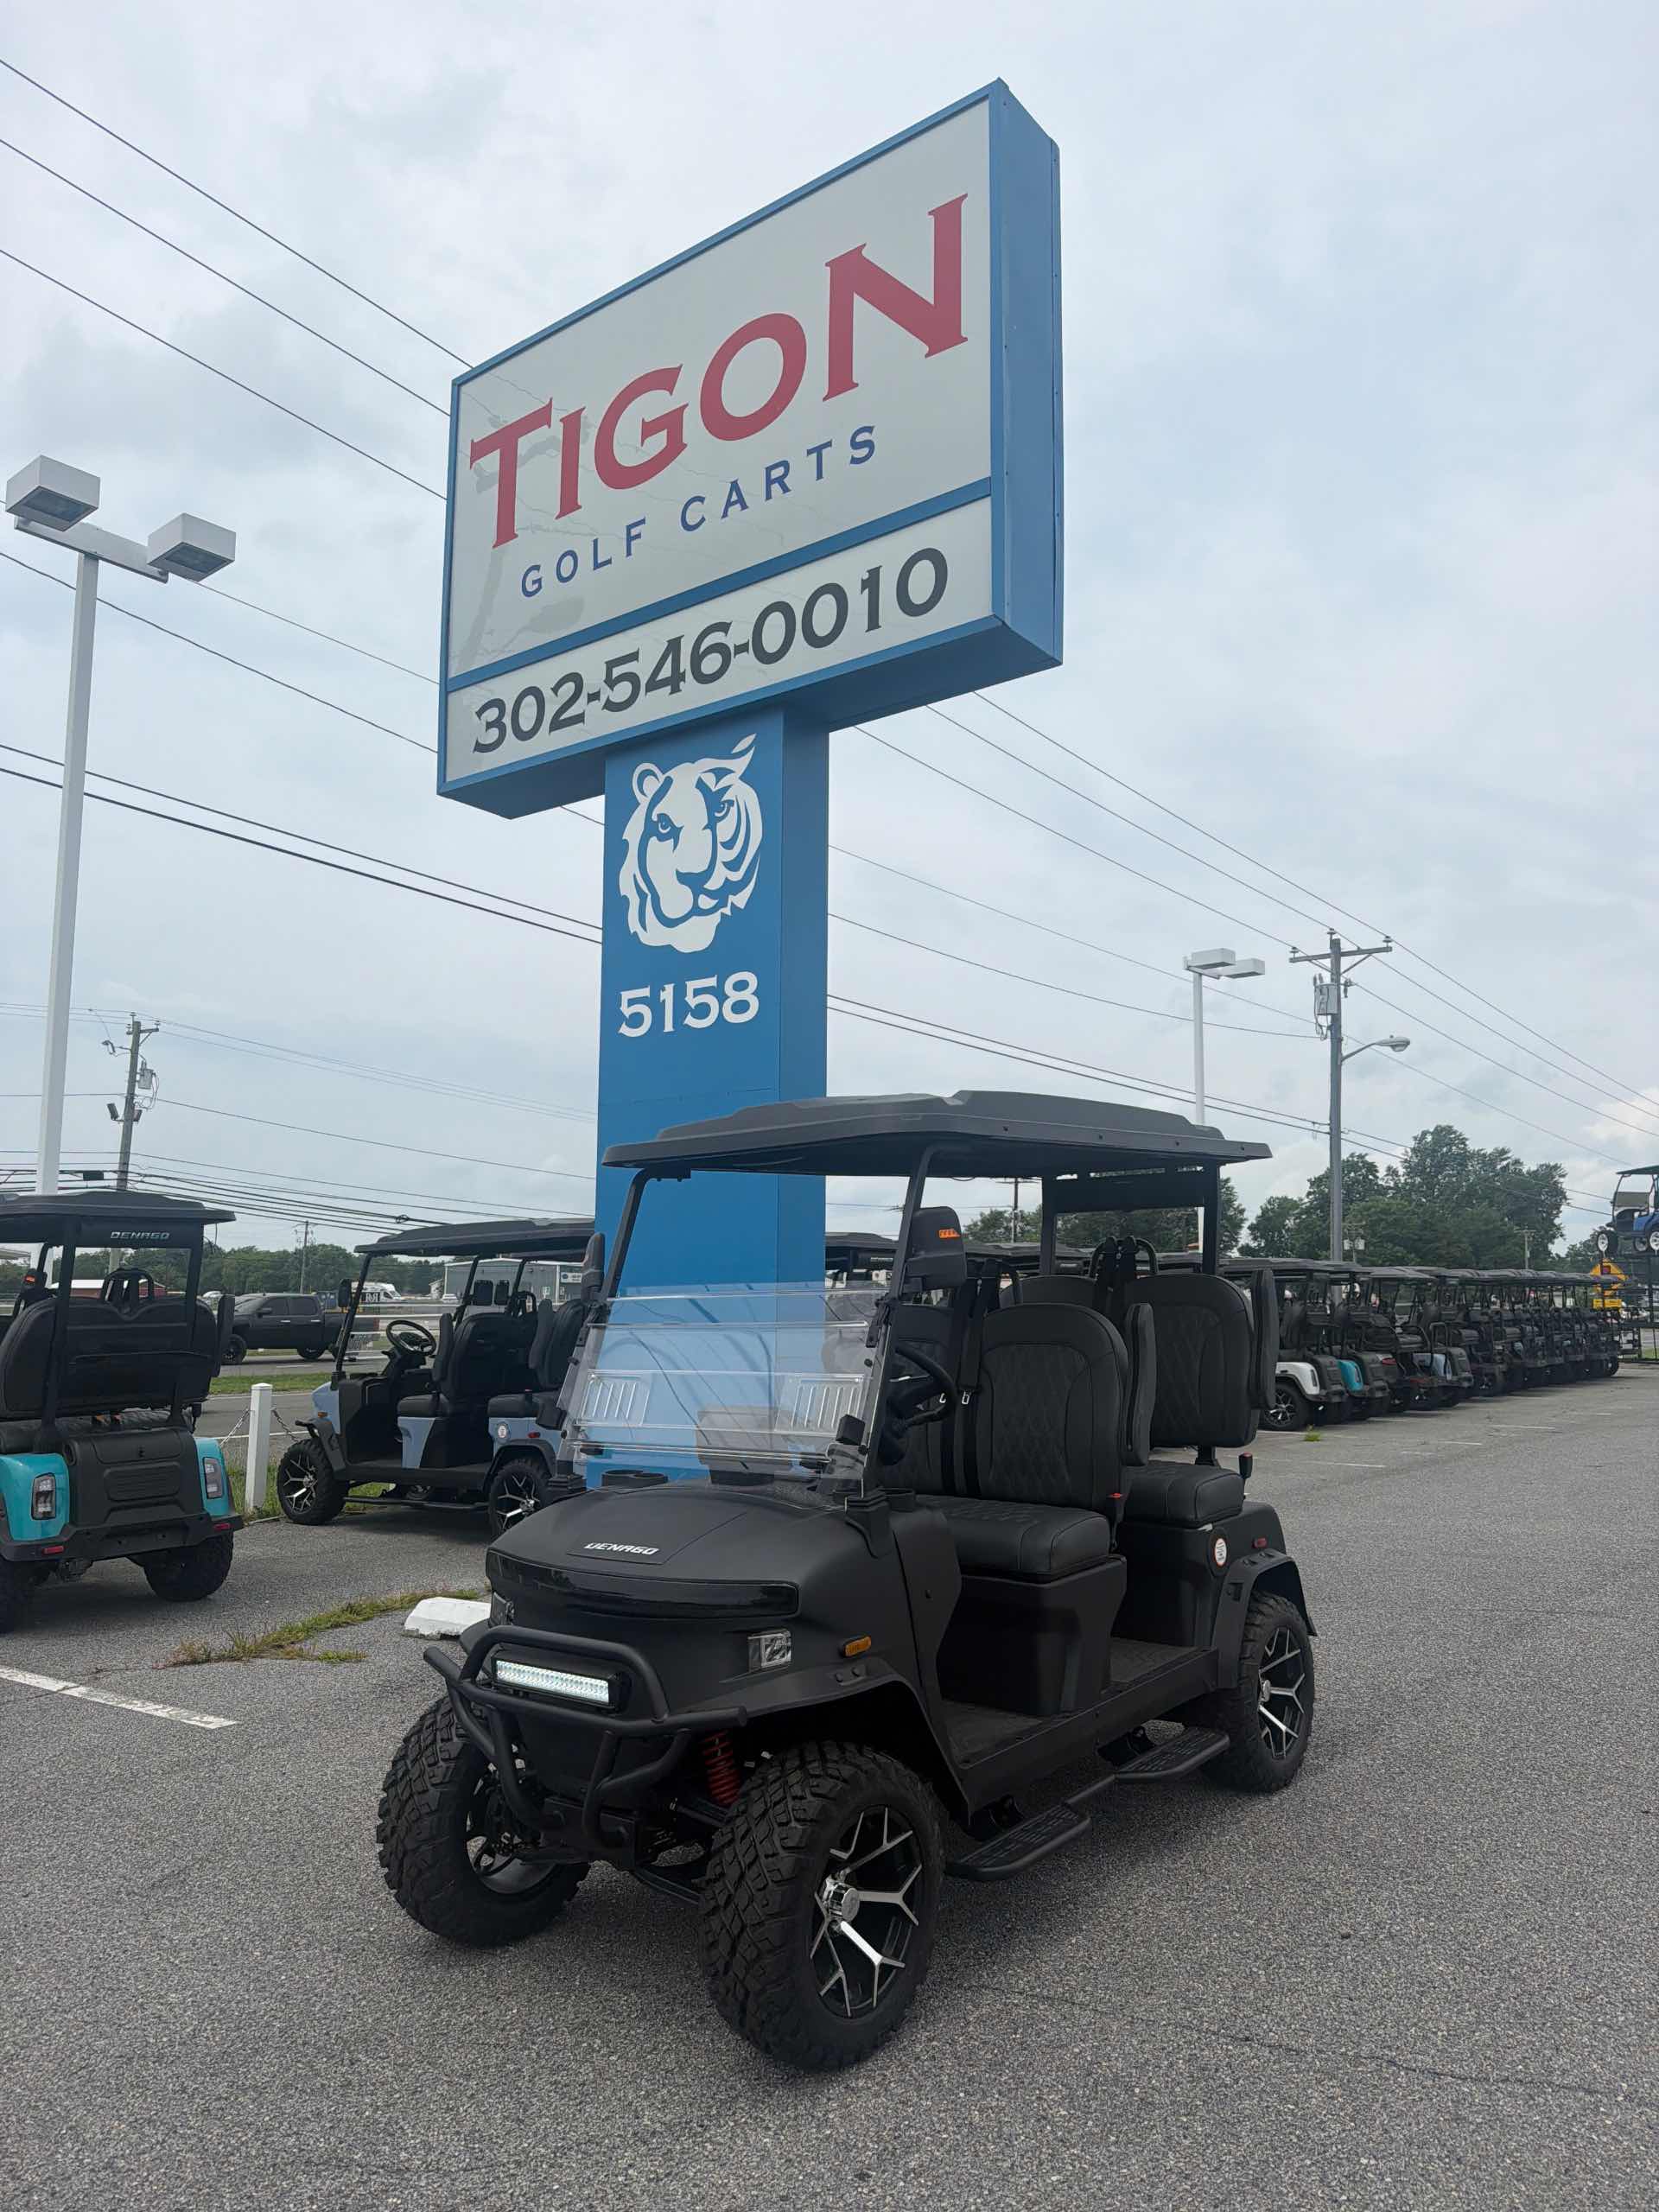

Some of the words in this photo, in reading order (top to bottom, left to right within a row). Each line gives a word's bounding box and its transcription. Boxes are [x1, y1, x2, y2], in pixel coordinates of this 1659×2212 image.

[469, 193, 969, 549] TIGON
[521, 517, 646, 598] GOLF
[679, 425, 876, 532] CARTS
[472, 547, 949, 754] 302-546-0010
[618, 971, 760, 1038] 5158
[110, 1231, 170, 1240] DENAGO
[583, 1542, 659, 1555] DENAGO
